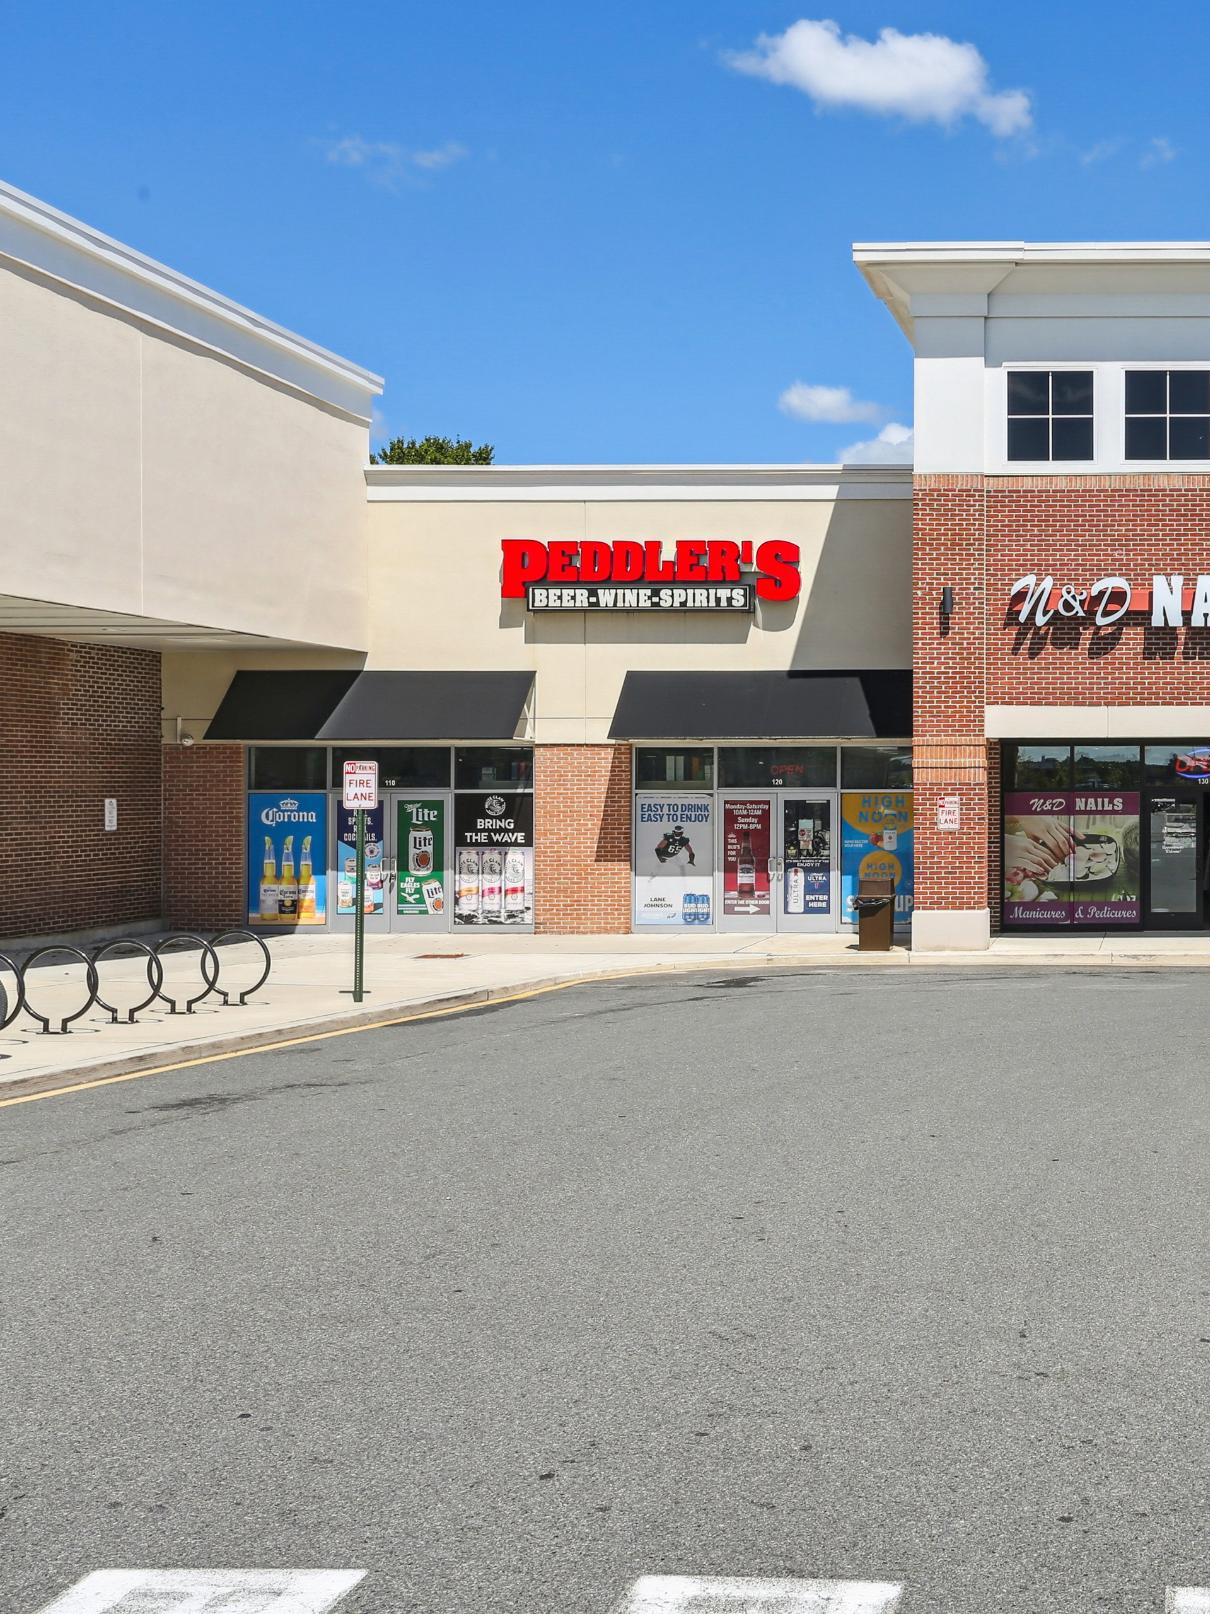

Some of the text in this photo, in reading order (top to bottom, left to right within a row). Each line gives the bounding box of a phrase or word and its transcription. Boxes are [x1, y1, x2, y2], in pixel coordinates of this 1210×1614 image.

[501, 539, 801, 602] PEDDLER'S
[534, 588, 745, 608] BEER-WINE-SPIRITS
[1011, 574, 1132, 627] N&D
[346, 764, 356, 773] NO
[349, 780, 372, 788] FIRE
[347, 793, 374, 801] LANE
[862, 795, 905, 808] HIGH
[641, 804, 710, 812] EASY TO DRINK
[1029, 798, 1123, 811] N&D NAILS
[261, 808, 317, 826] Corona
[411, 806, 438, 824] Lite
[641, 814, 710, 822] EASY TO ENJOY
[858, 811, 909, 823] NON
[477, 819, 515, 829] BRING
[413, 836, 433, 850] Lite
[465, 832, 525, 843] THE WAVE
[866, 863, 895, 871] HIGH
[1010, 906, 1137, 919] Manicures & Pedicures
